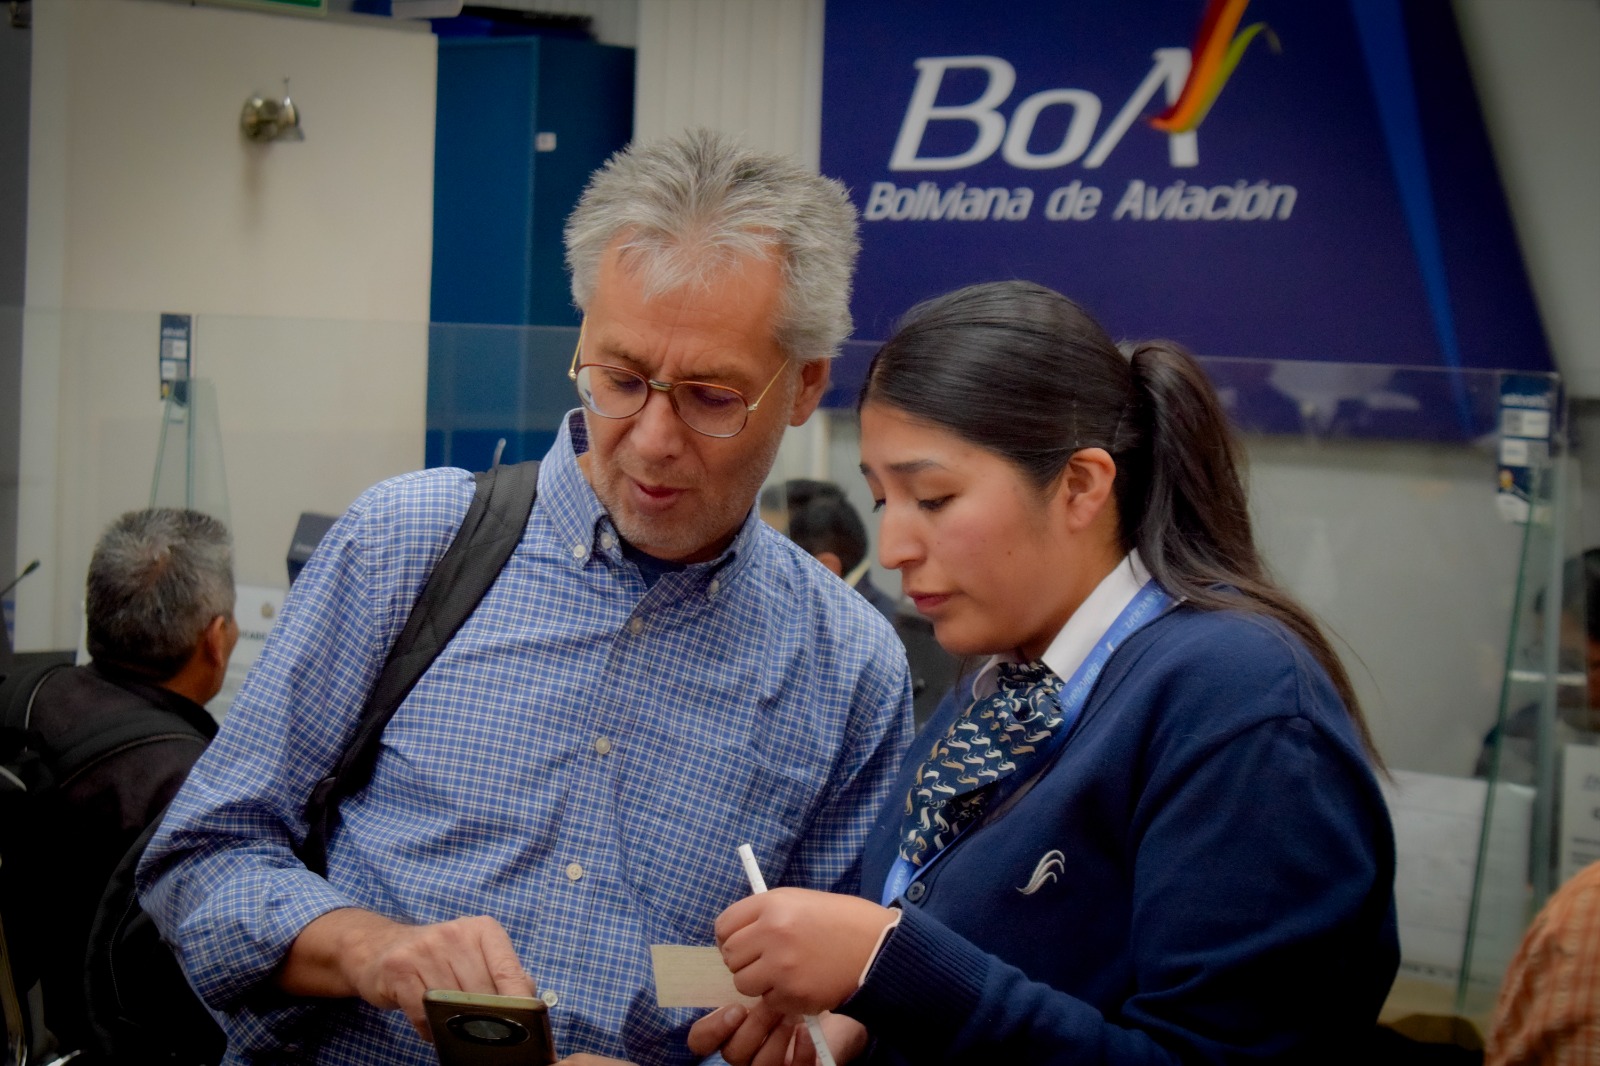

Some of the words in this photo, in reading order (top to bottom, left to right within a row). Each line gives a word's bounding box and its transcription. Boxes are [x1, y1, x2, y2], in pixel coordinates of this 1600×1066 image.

[888, 47, 1200, 172] BoA
[865, 181, 1035, 222] Boliviana
[1044, 180, 1103, 221] de
[1112, 180, 1298, 221] Aviación
